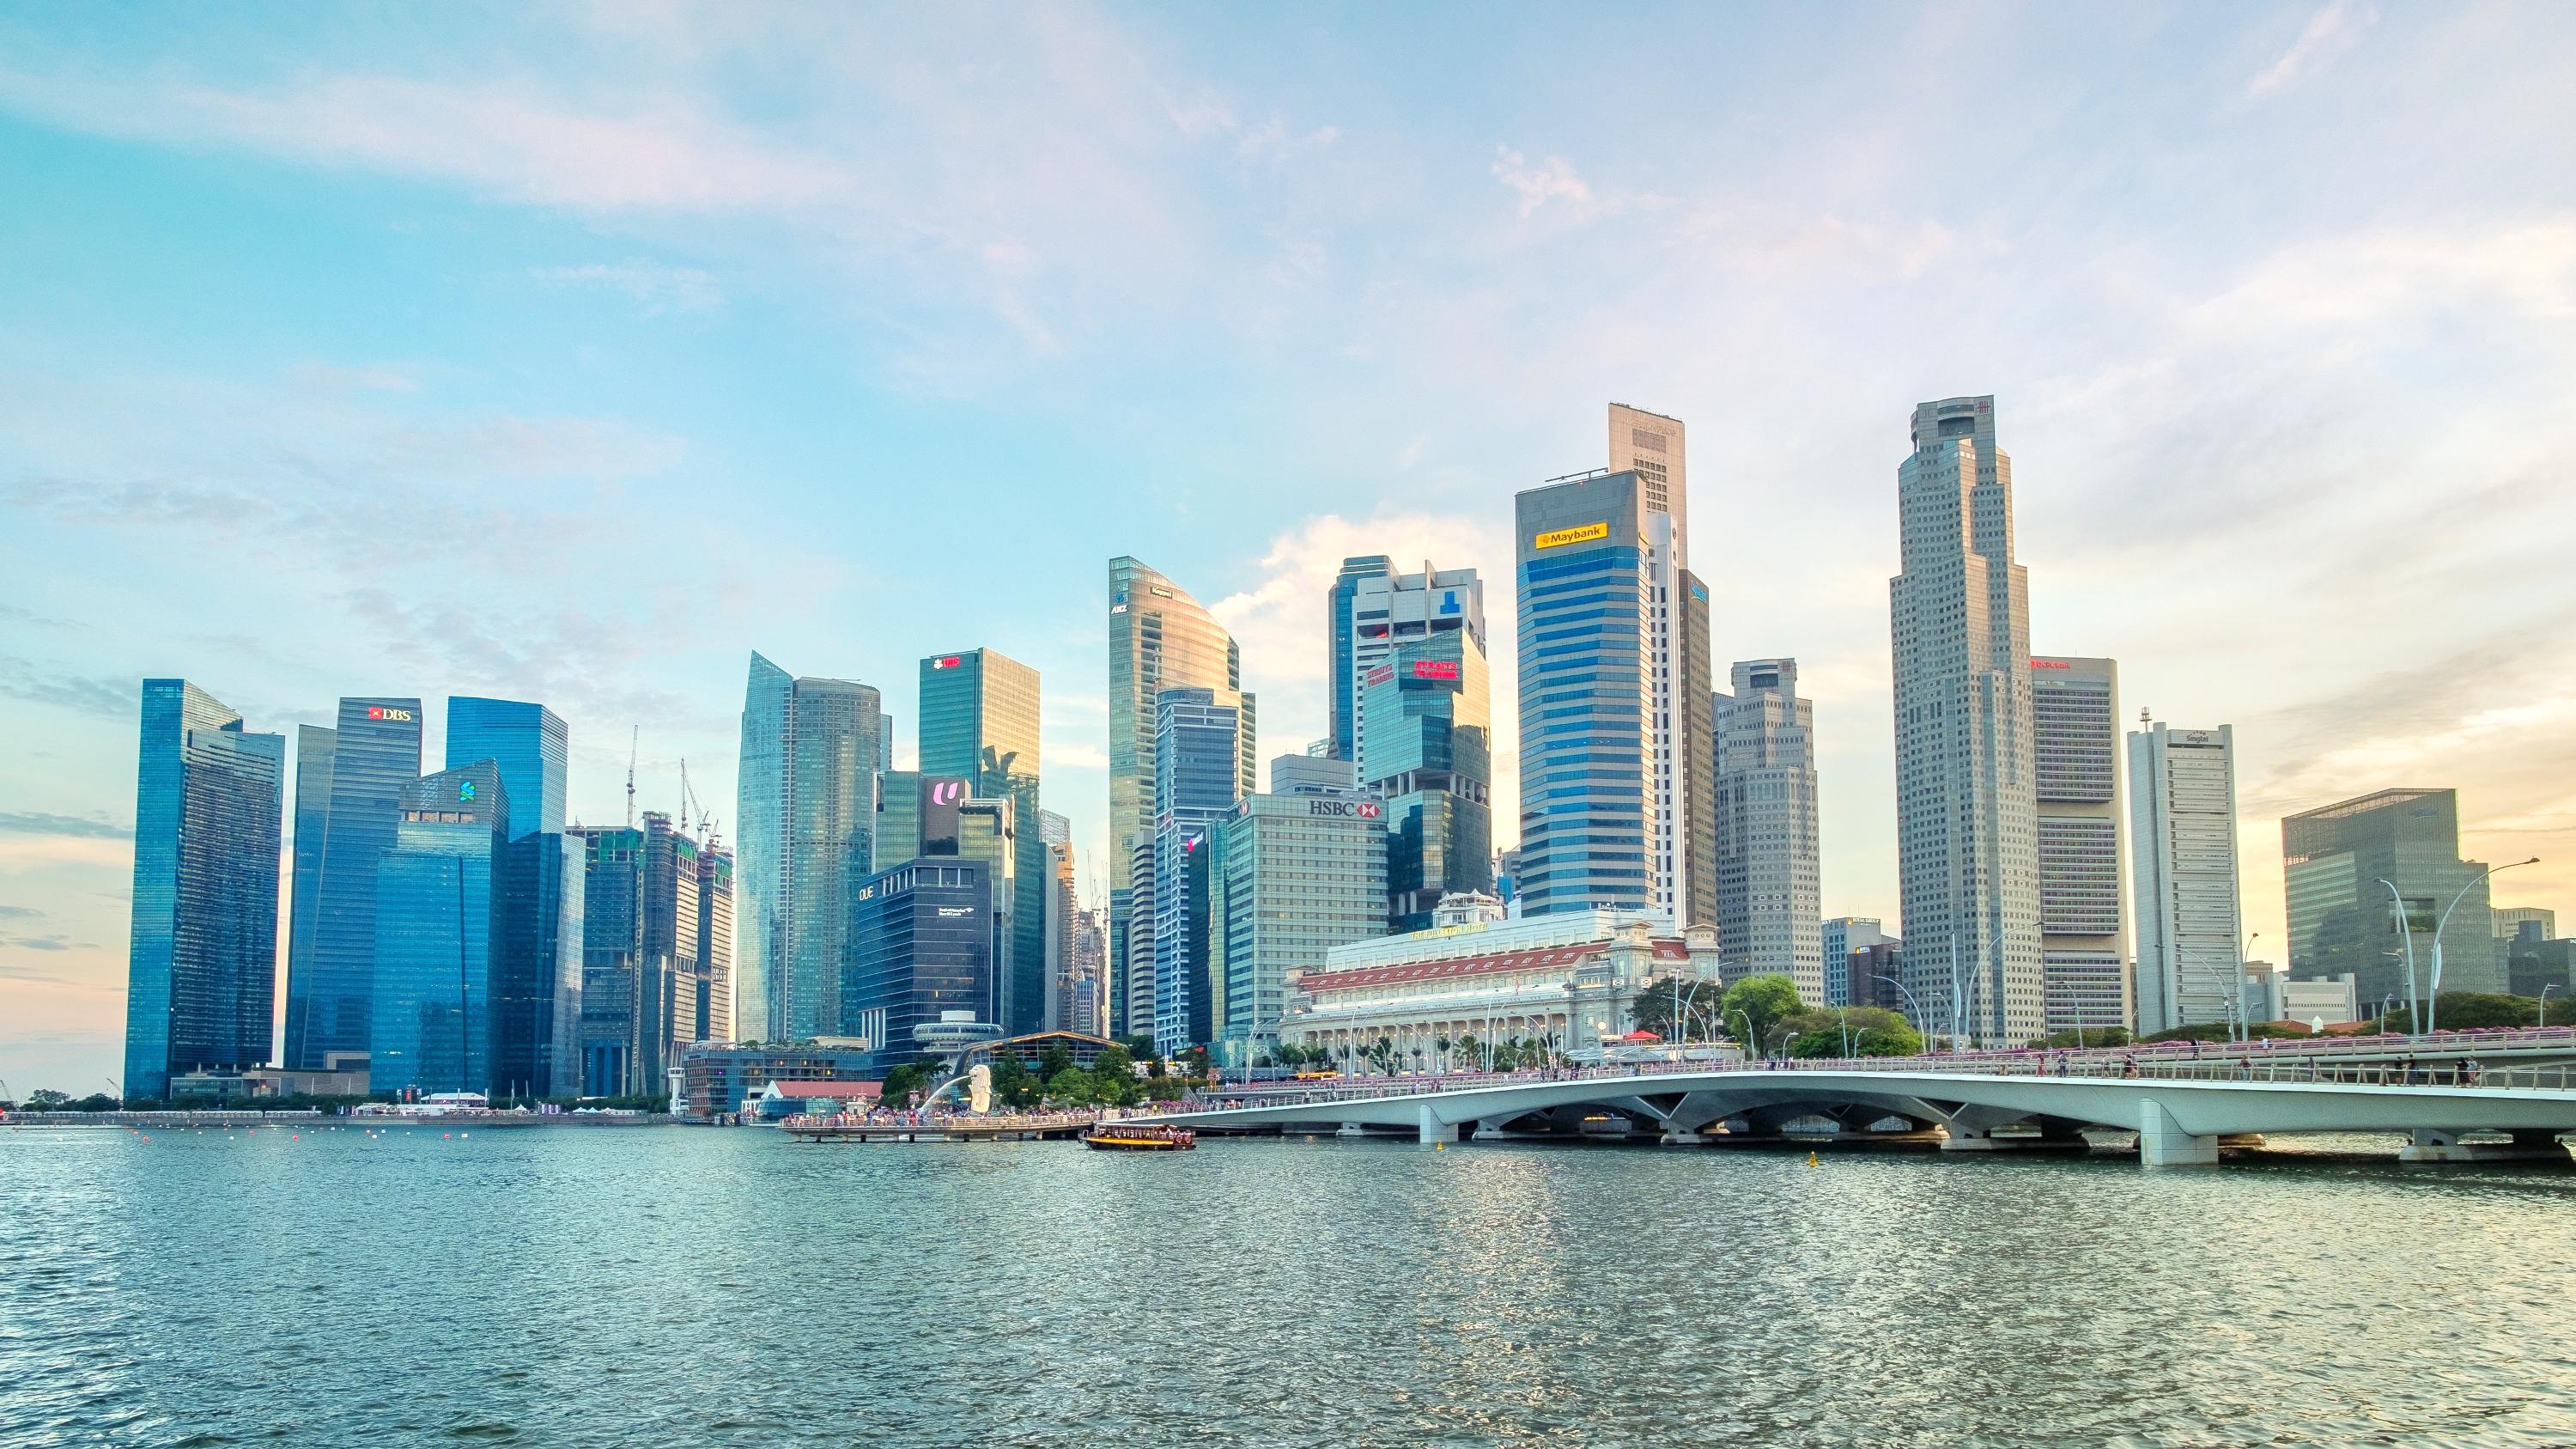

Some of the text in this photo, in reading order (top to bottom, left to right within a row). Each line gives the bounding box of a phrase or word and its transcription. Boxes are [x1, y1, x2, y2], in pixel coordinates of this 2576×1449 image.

[1551, 526, 1601, 544] Maybank
[1111, 605, 1127, 615] ANZ
[383, 709, 411, 721] DBS
[1309, 800, 1355, 817] HSBC
[859, 886, 874, 901] OUE
[1411, 922, 1488, 941] THE FULLERTON HOTEL
